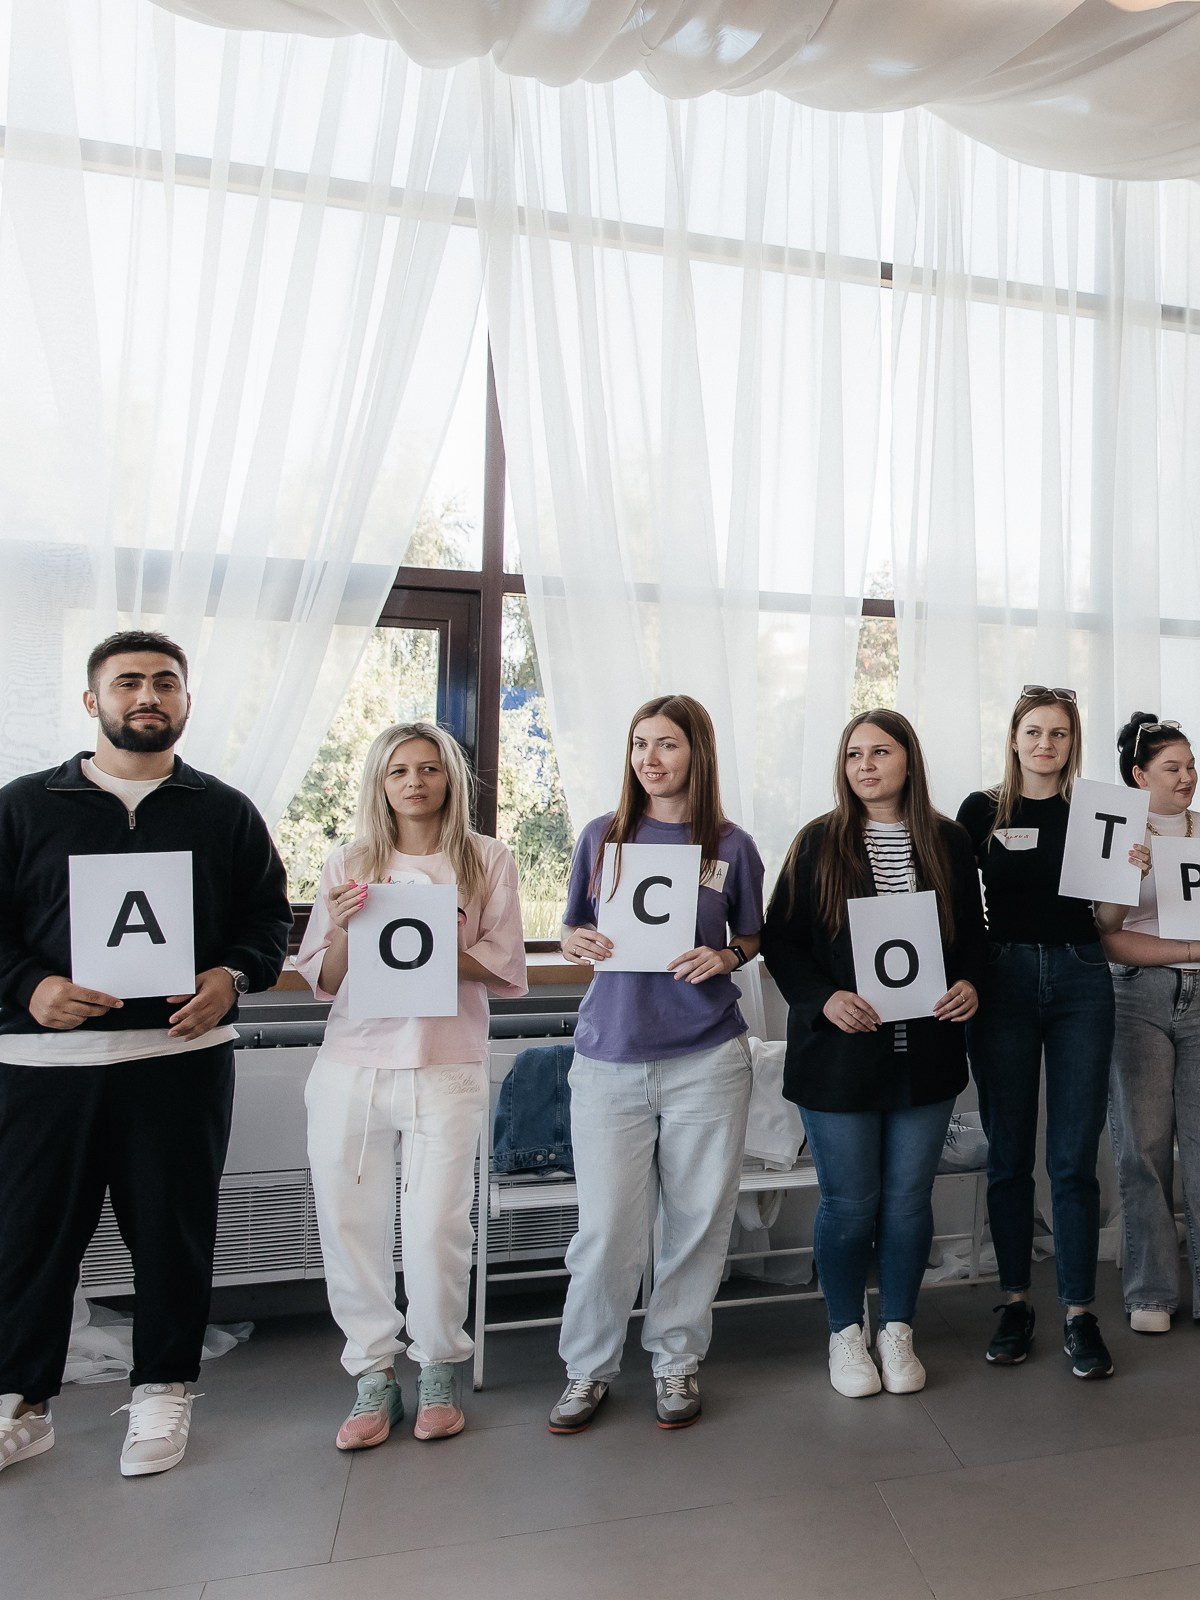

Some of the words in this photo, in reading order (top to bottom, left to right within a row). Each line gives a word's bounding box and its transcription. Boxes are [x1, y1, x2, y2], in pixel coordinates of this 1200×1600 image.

[1095, 812, 1127, 859] Т
[107, 891, 166, 947] А
[633, 876, 673, 925] С
[379, 918, 434, 970] О
[875, 939, 919, 988] О
